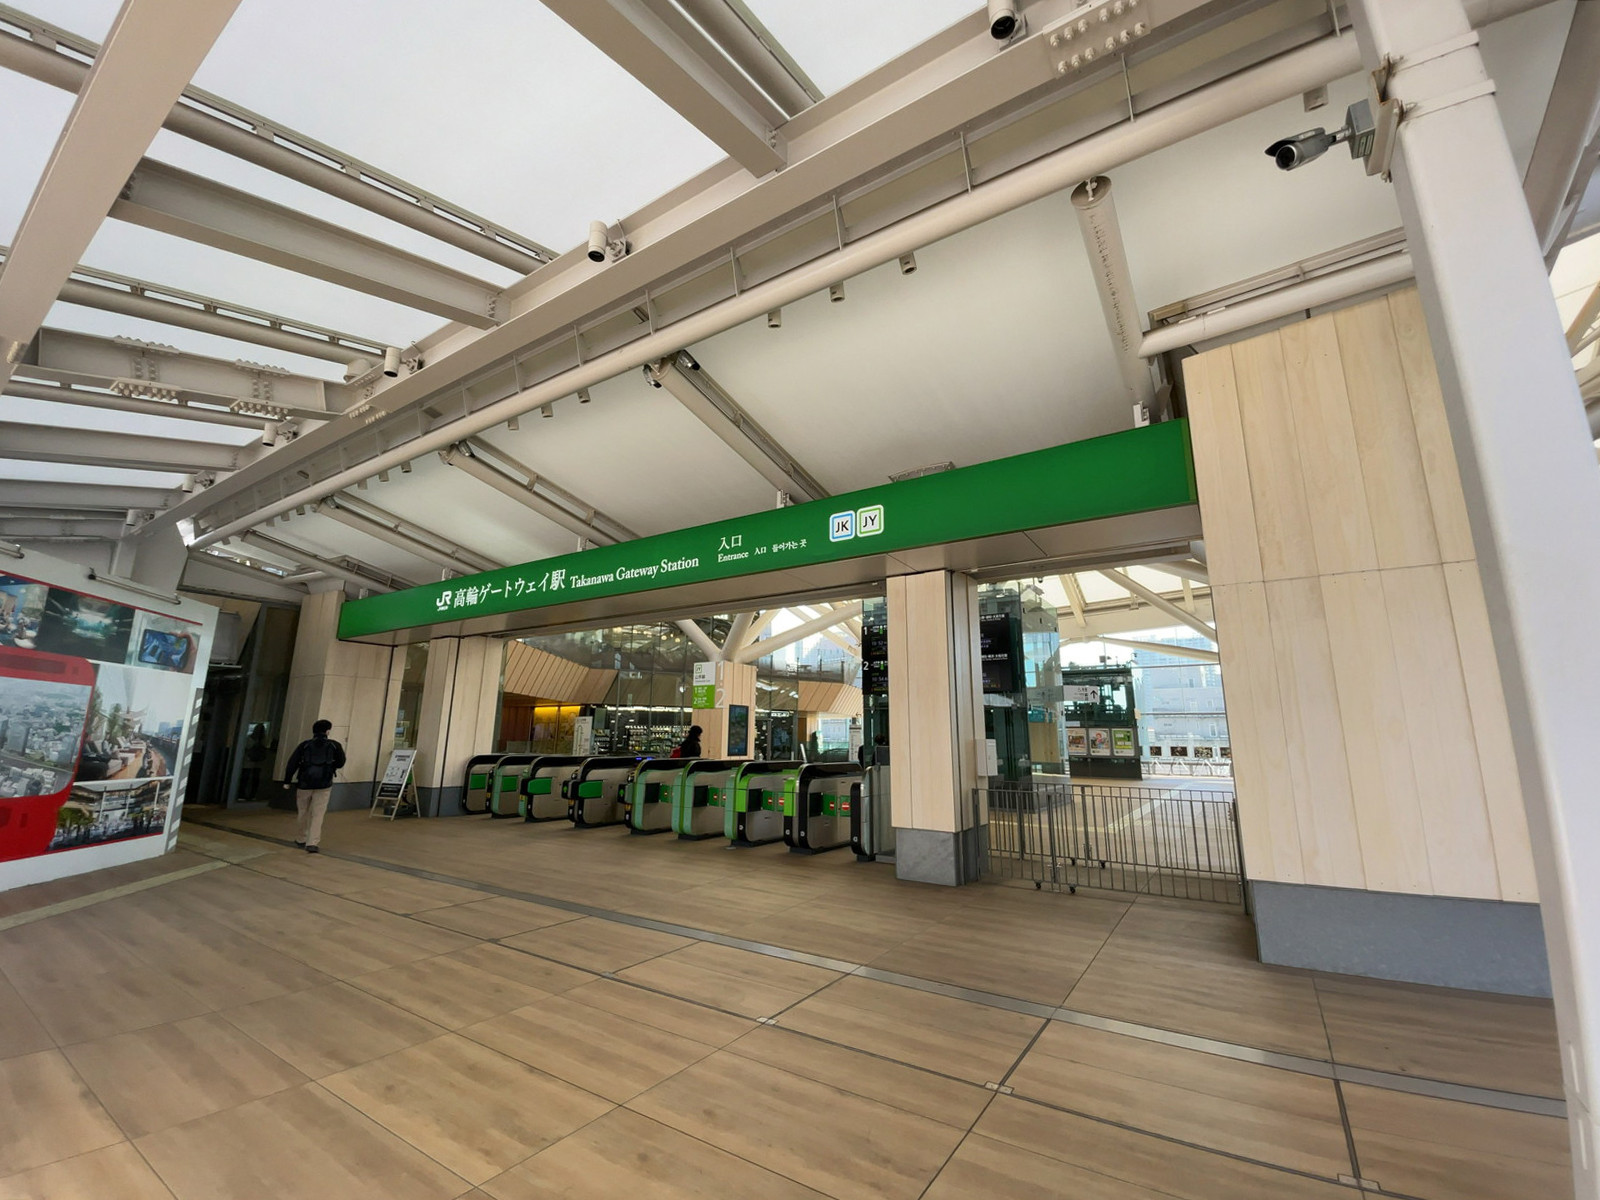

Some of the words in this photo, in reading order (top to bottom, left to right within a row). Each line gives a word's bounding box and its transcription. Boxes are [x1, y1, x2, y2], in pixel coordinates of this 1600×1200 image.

[835, 519, 850, 533] JK
[863, 514, 878, 528] JY
[718, 534, 743, 551] 入口
[754, 546, 767, 556] 入口
[717, 551, 749, 563] Entrance
[570, 573, 614, 589] Takanawa
[616, 566, 659, 580] Gateway
[660, 556, 700, 573] Station
[453, 568, 566, 609] 高輪ゲートウェイ駅
[436, 590, 452, 606] JR
[863, 626, 868, 636] 1
[717, 660, 725, 681] 1
[863, 661, 869, 671] 2
[714, 688, 726, 708] 2
